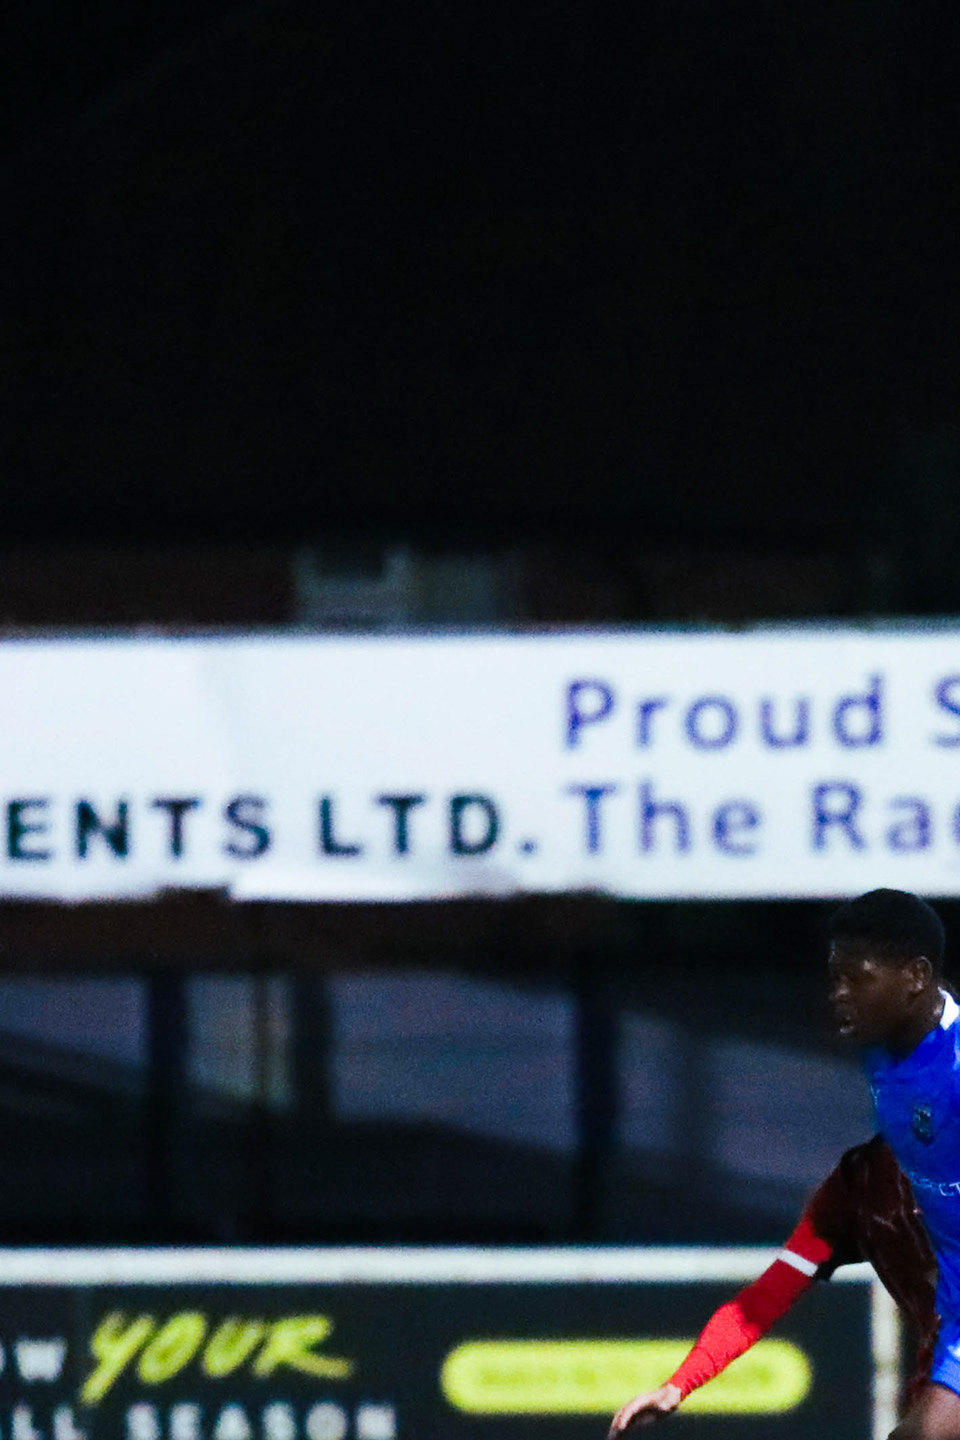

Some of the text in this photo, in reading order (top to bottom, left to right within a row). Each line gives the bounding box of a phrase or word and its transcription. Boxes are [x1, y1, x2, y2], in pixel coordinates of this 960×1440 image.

[566, 670, 884, 752] Proud
[4, 792, 534, 863] ENTS LTD.
[571, 776, 760, 856] The
[0, 1338, 66, 1382] W
